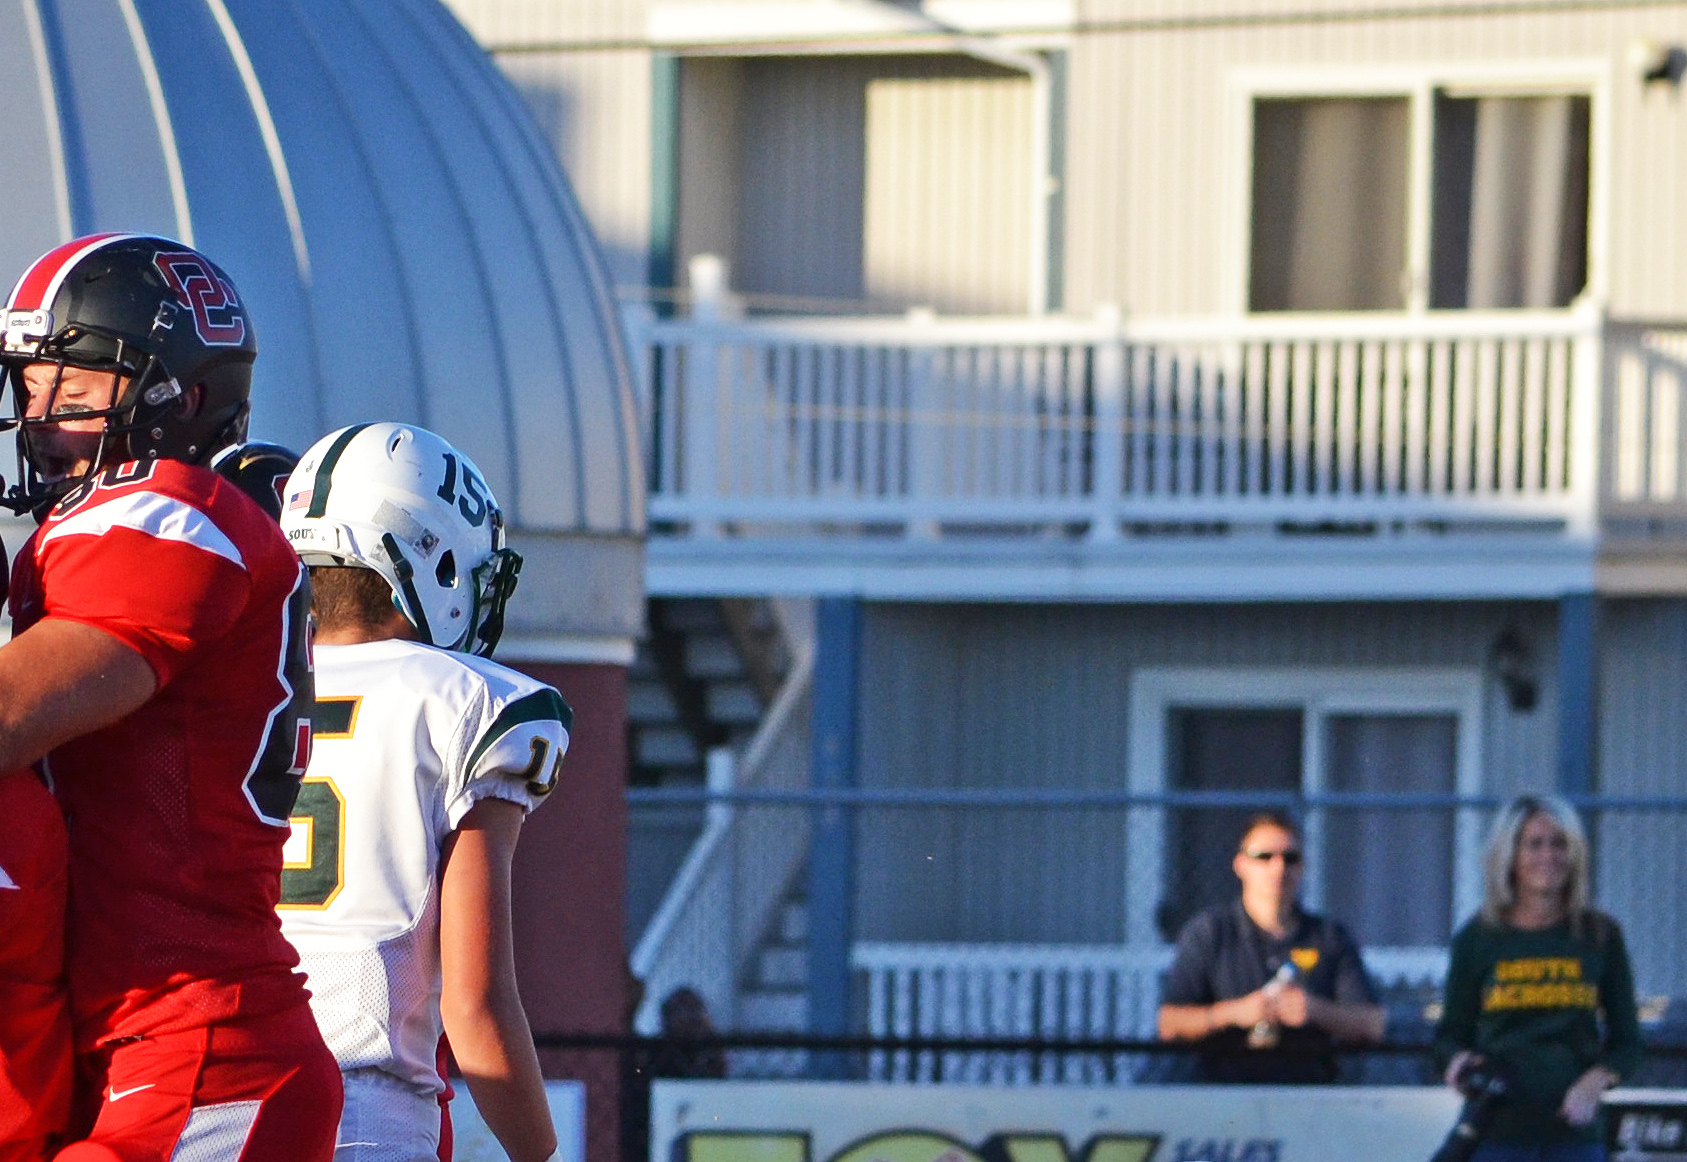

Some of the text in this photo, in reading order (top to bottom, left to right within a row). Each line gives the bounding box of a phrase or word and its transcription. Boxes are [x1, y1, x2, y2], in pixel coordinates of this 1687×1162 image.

[437, 452, 487, 527] 15
[288, 528, 317, 541] SOUT
[274, 694, 363, 911] 5
